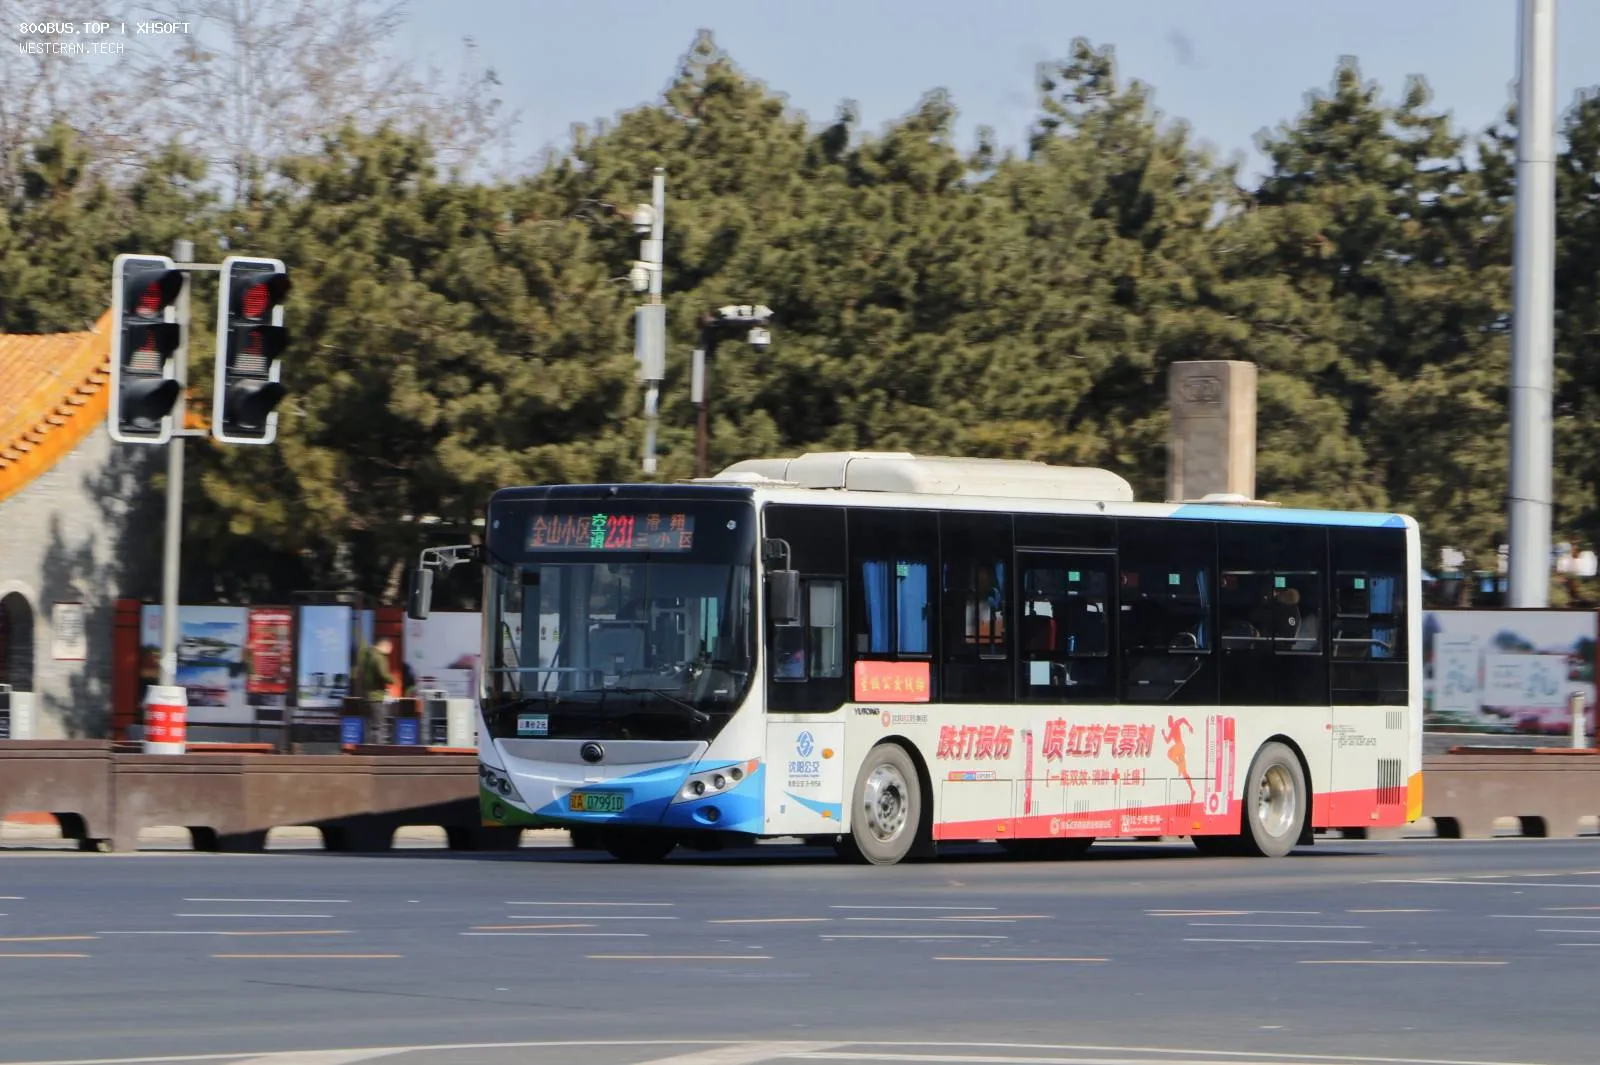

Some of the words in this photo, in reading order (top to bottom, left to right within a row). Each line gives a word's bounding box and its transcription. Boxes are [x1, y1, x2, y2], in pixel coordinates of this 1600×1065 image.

[590, 513, 608, 548] 空调
[605, 514, 637, 548] 231
[854, 708, 880, 716] YUTONG
[936, 725, 1014, 760] 跌打损伤
[1042, 718, 1155, 762] 喷红药气雾剂
[788, 760, 820, 774] 沈阳公交
